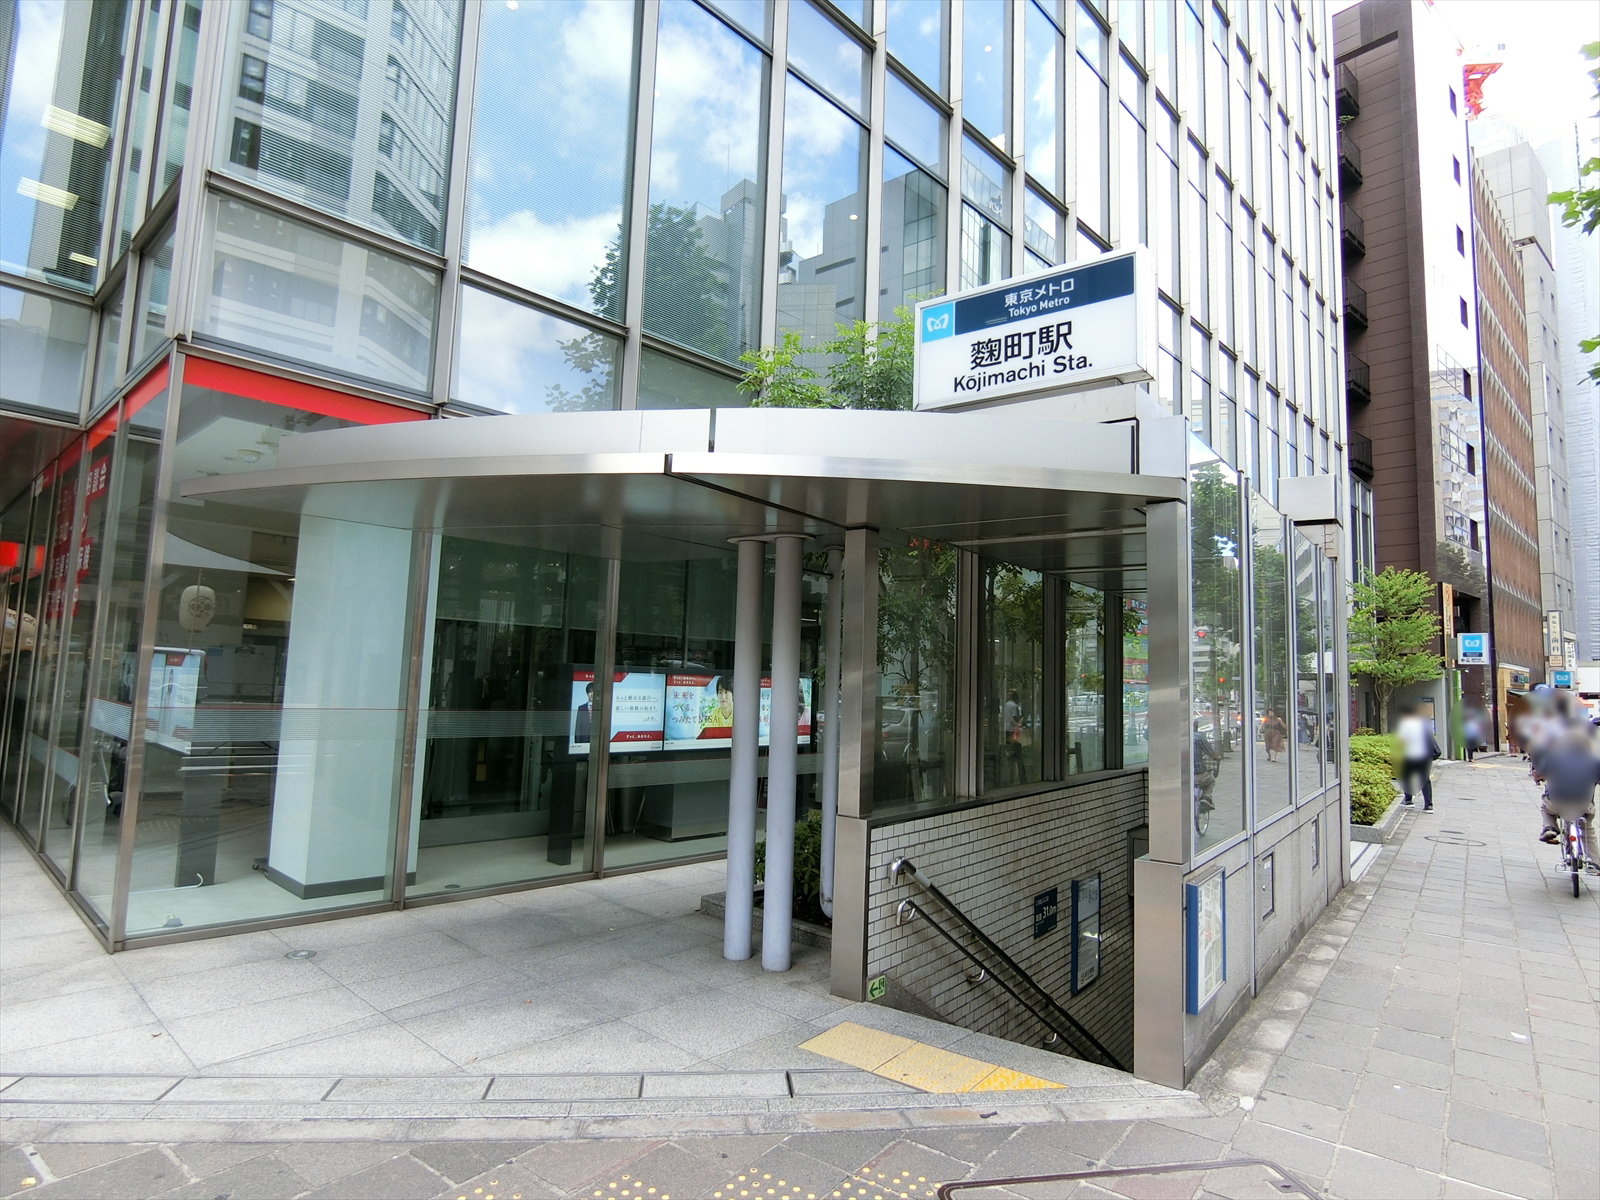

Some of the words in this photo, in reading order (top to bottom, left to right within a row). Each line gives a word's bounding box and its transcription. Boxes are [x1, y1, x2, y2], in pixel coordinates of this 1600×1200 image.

[1004, 278, 1075, 307] 東京メトロ
[1008, 303, 1038, 319] Tokyo
[1039, 295, 1070, 312] Metro
[954, 360, 1046, 392] Kōjimachi
[1052, 354, 1093, 374] Sta.
[672, 703, 694, 712] つくる。
[673, 691, 695, 700] 未来を
